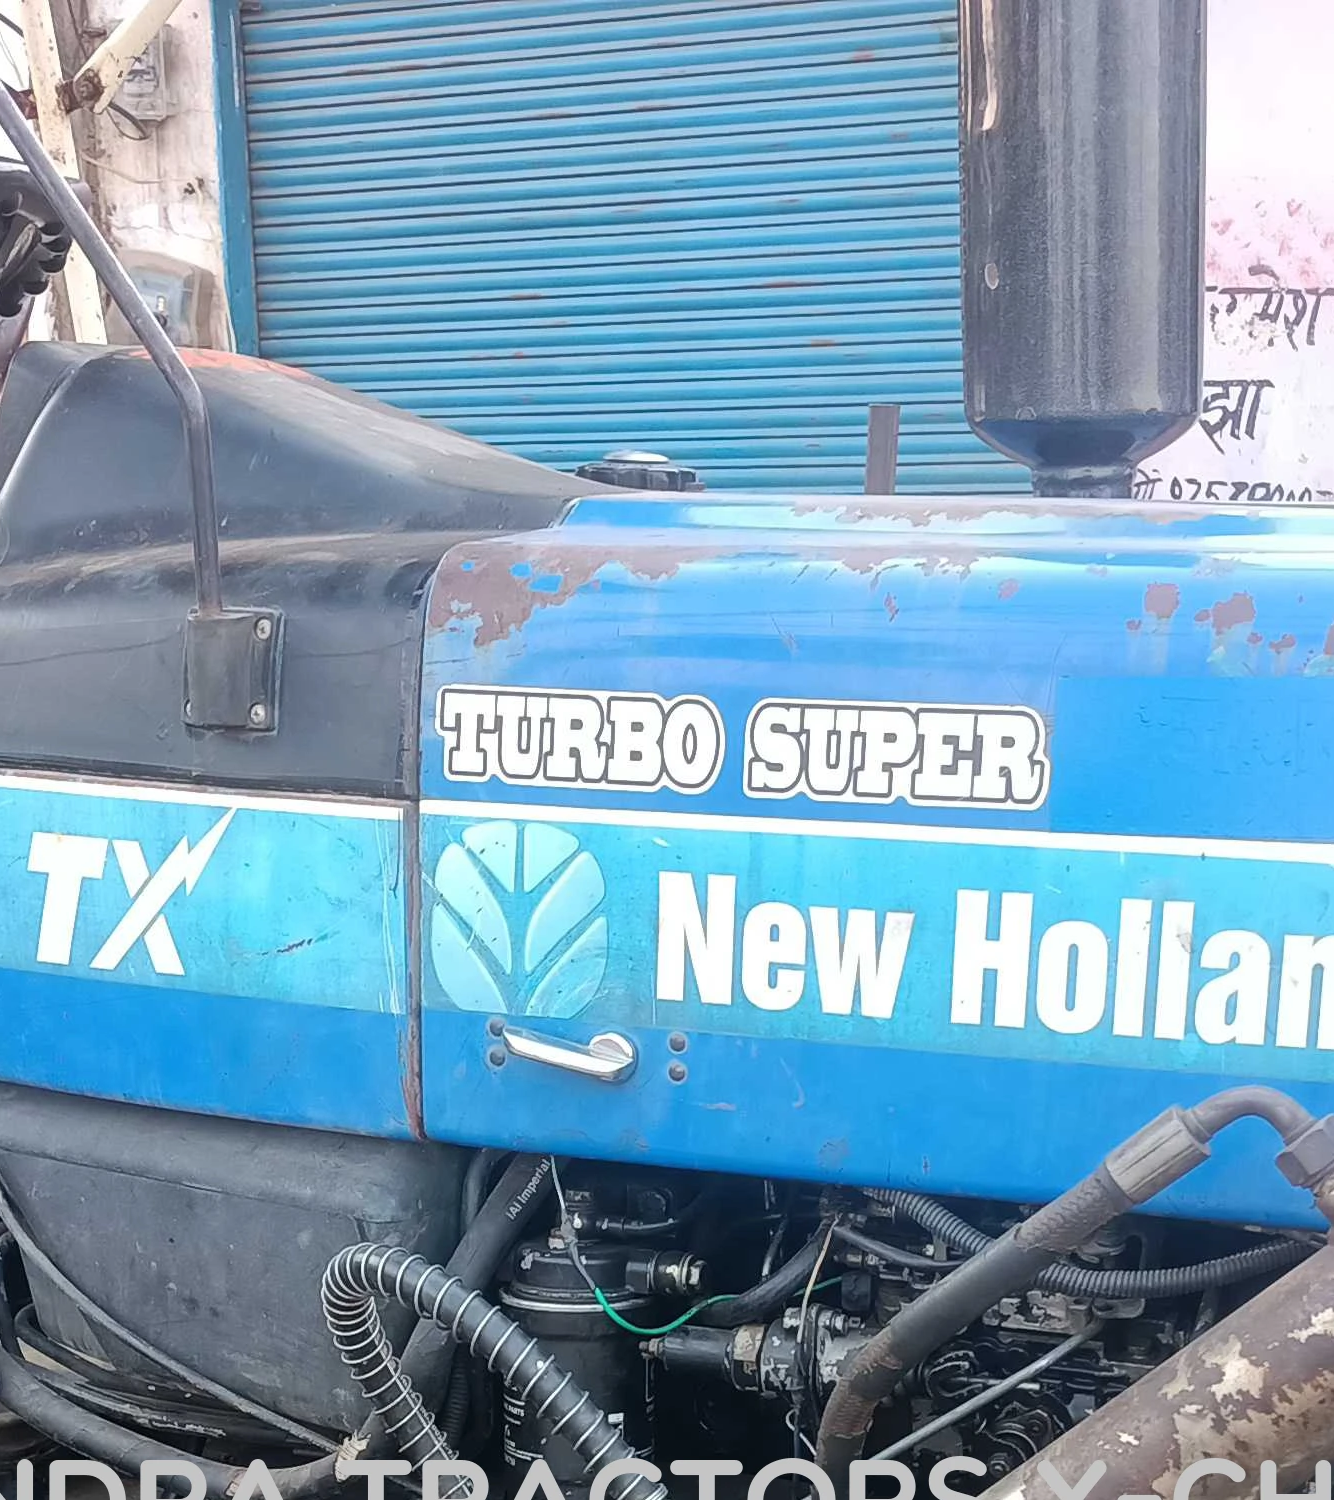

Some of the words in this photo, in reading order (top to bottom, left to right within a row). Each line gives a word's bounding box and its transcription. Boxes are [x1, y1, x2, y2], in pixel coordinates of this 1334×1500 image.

[437, 685, 724, 794] TURBO
[744, 699, 1050, 809] SUPER
[27, 807, 237, 976] TX
[656, 870, 915, 1019] New
[517, 1158, 551, 1204] Imperial
